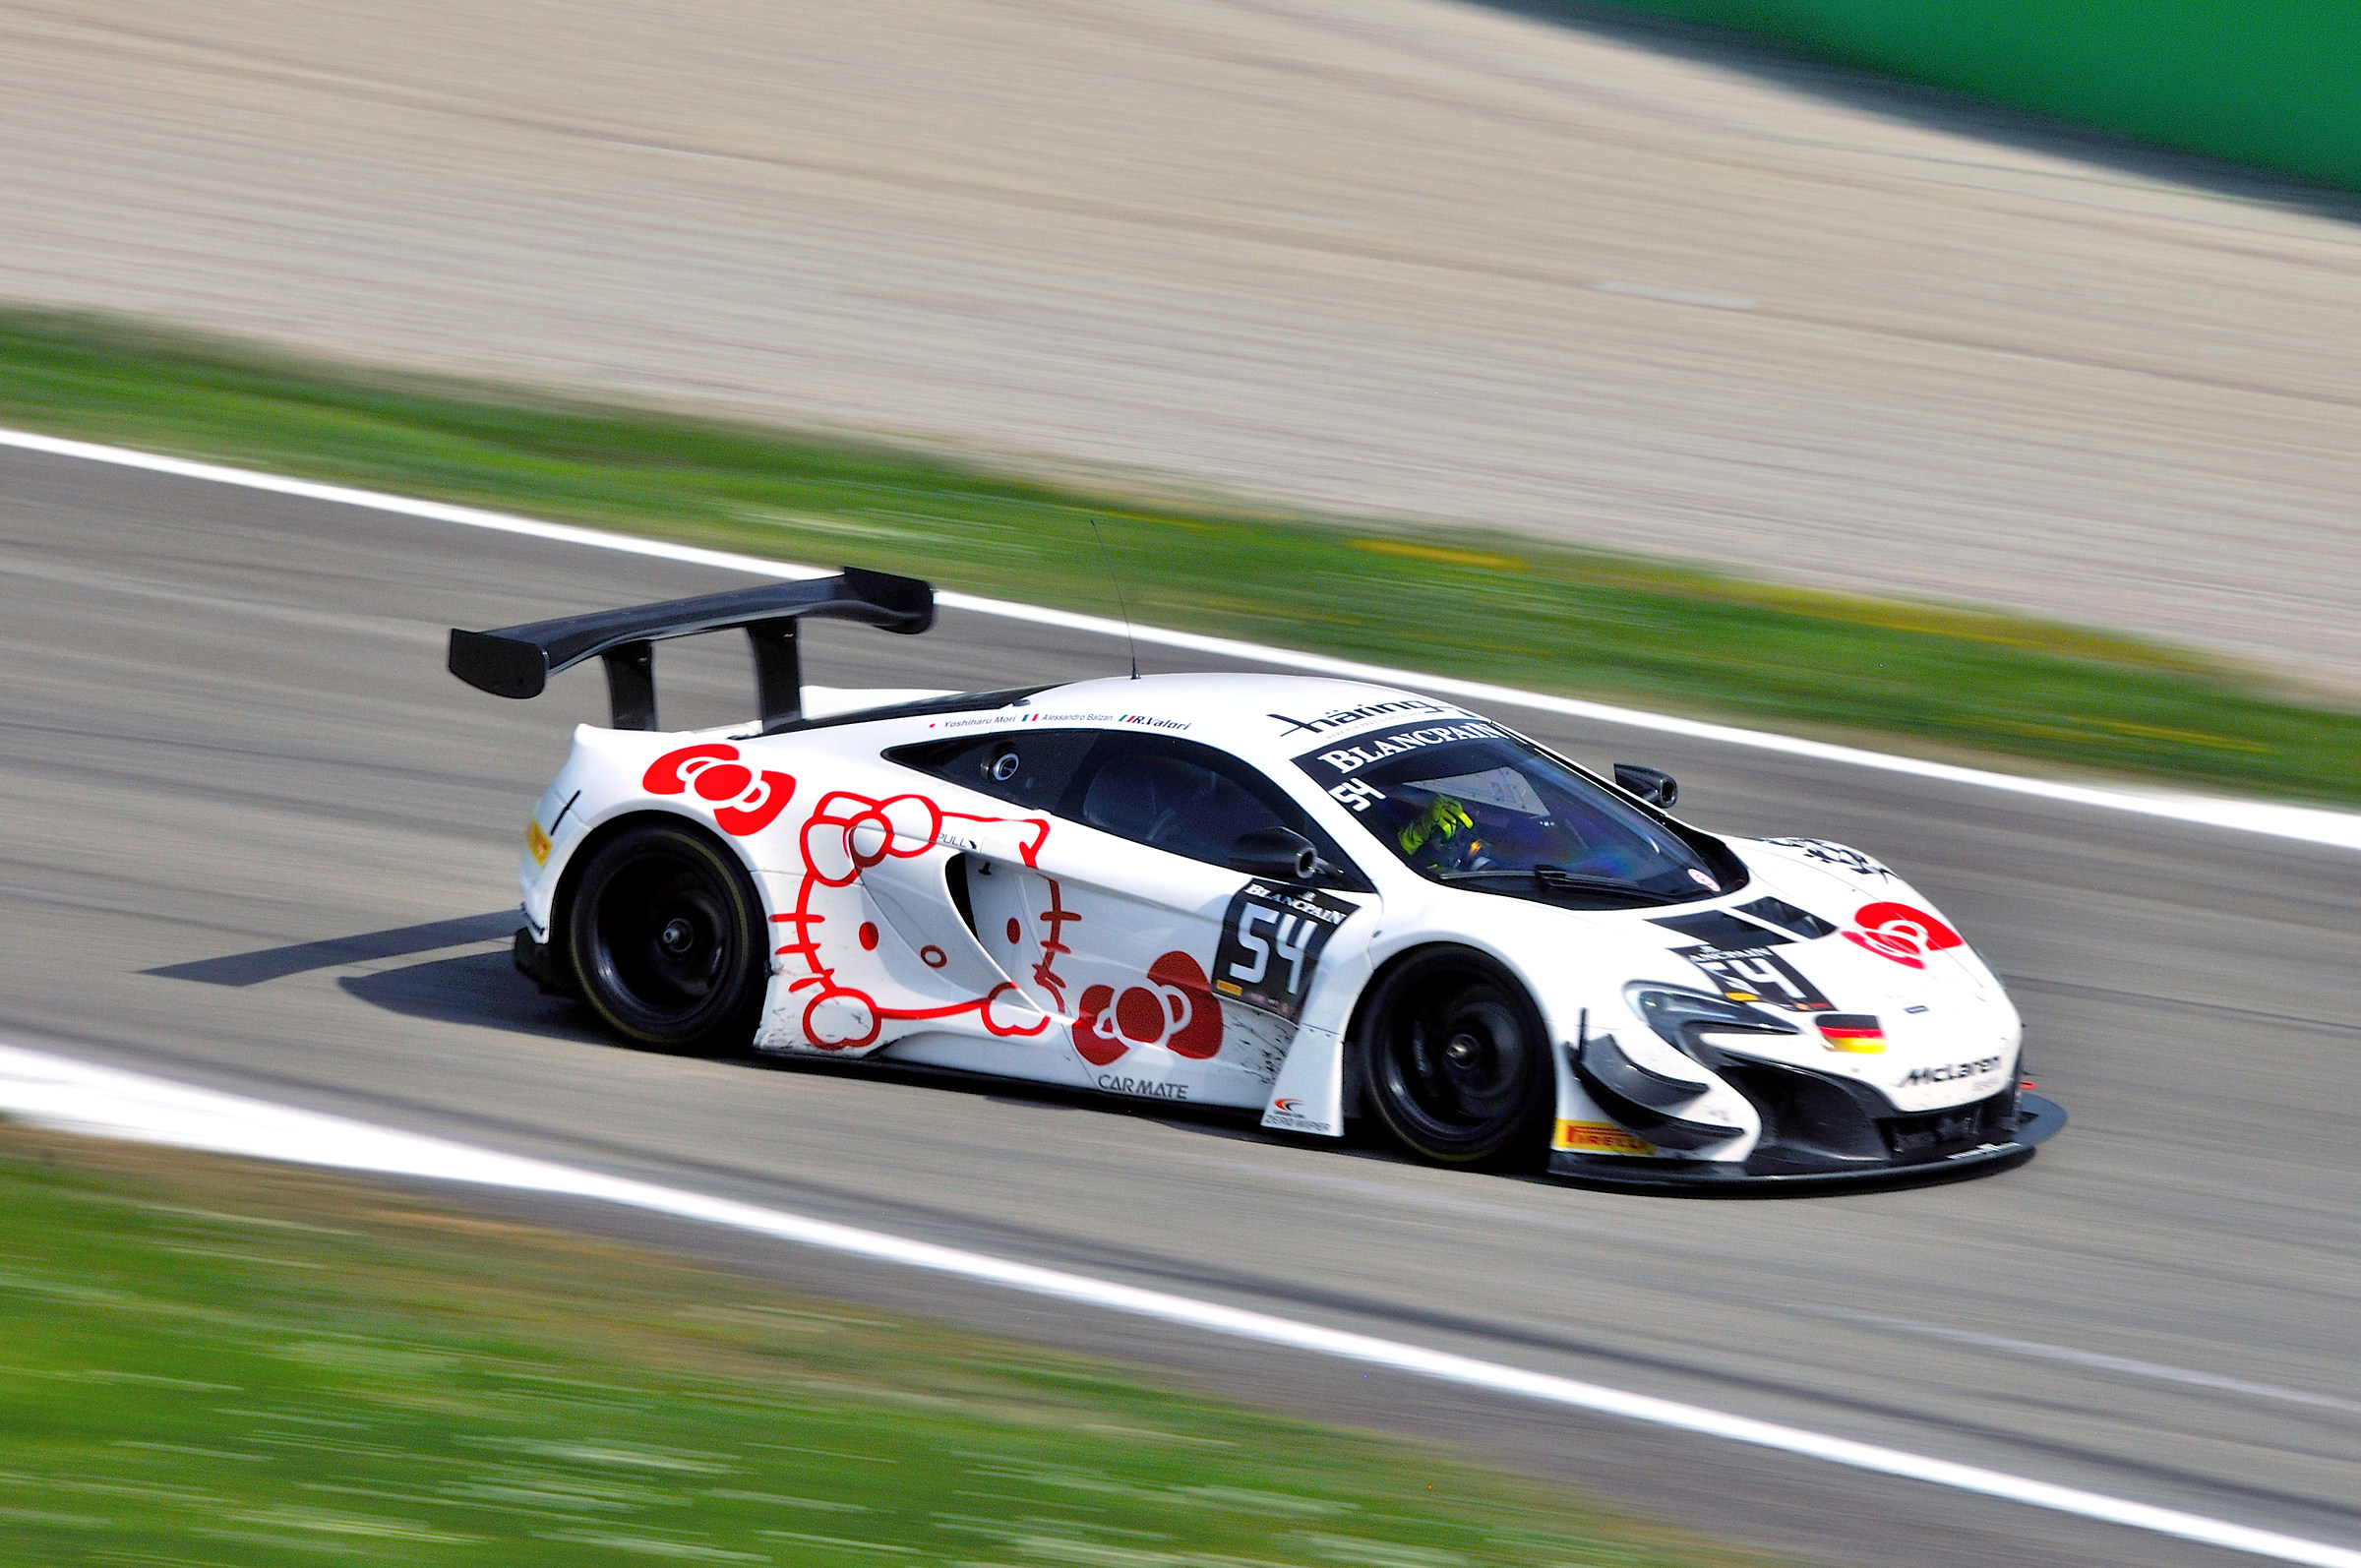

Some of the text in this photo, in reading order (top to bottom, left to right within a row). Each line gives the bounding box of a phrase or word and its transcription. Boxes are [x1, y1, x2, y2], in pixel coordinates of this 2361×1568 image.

[944, 714, 1017, 728] Yoshiharu Mori
[1041, 713, 1114, 722] Alessandro Balzan
[1132, 715, 1192, 731] R.Valori
[1318, 721, 1510, 774] BLANCPAIN
[1328, 777, 1387, 813] 54
[938, 832, 966, 848] PULL
[1243, 883, 1348, 925] BLANCPAIN
[1229, 902, 1319, 995] 54
[1897, 1055, 2001, 1088] McLaren
